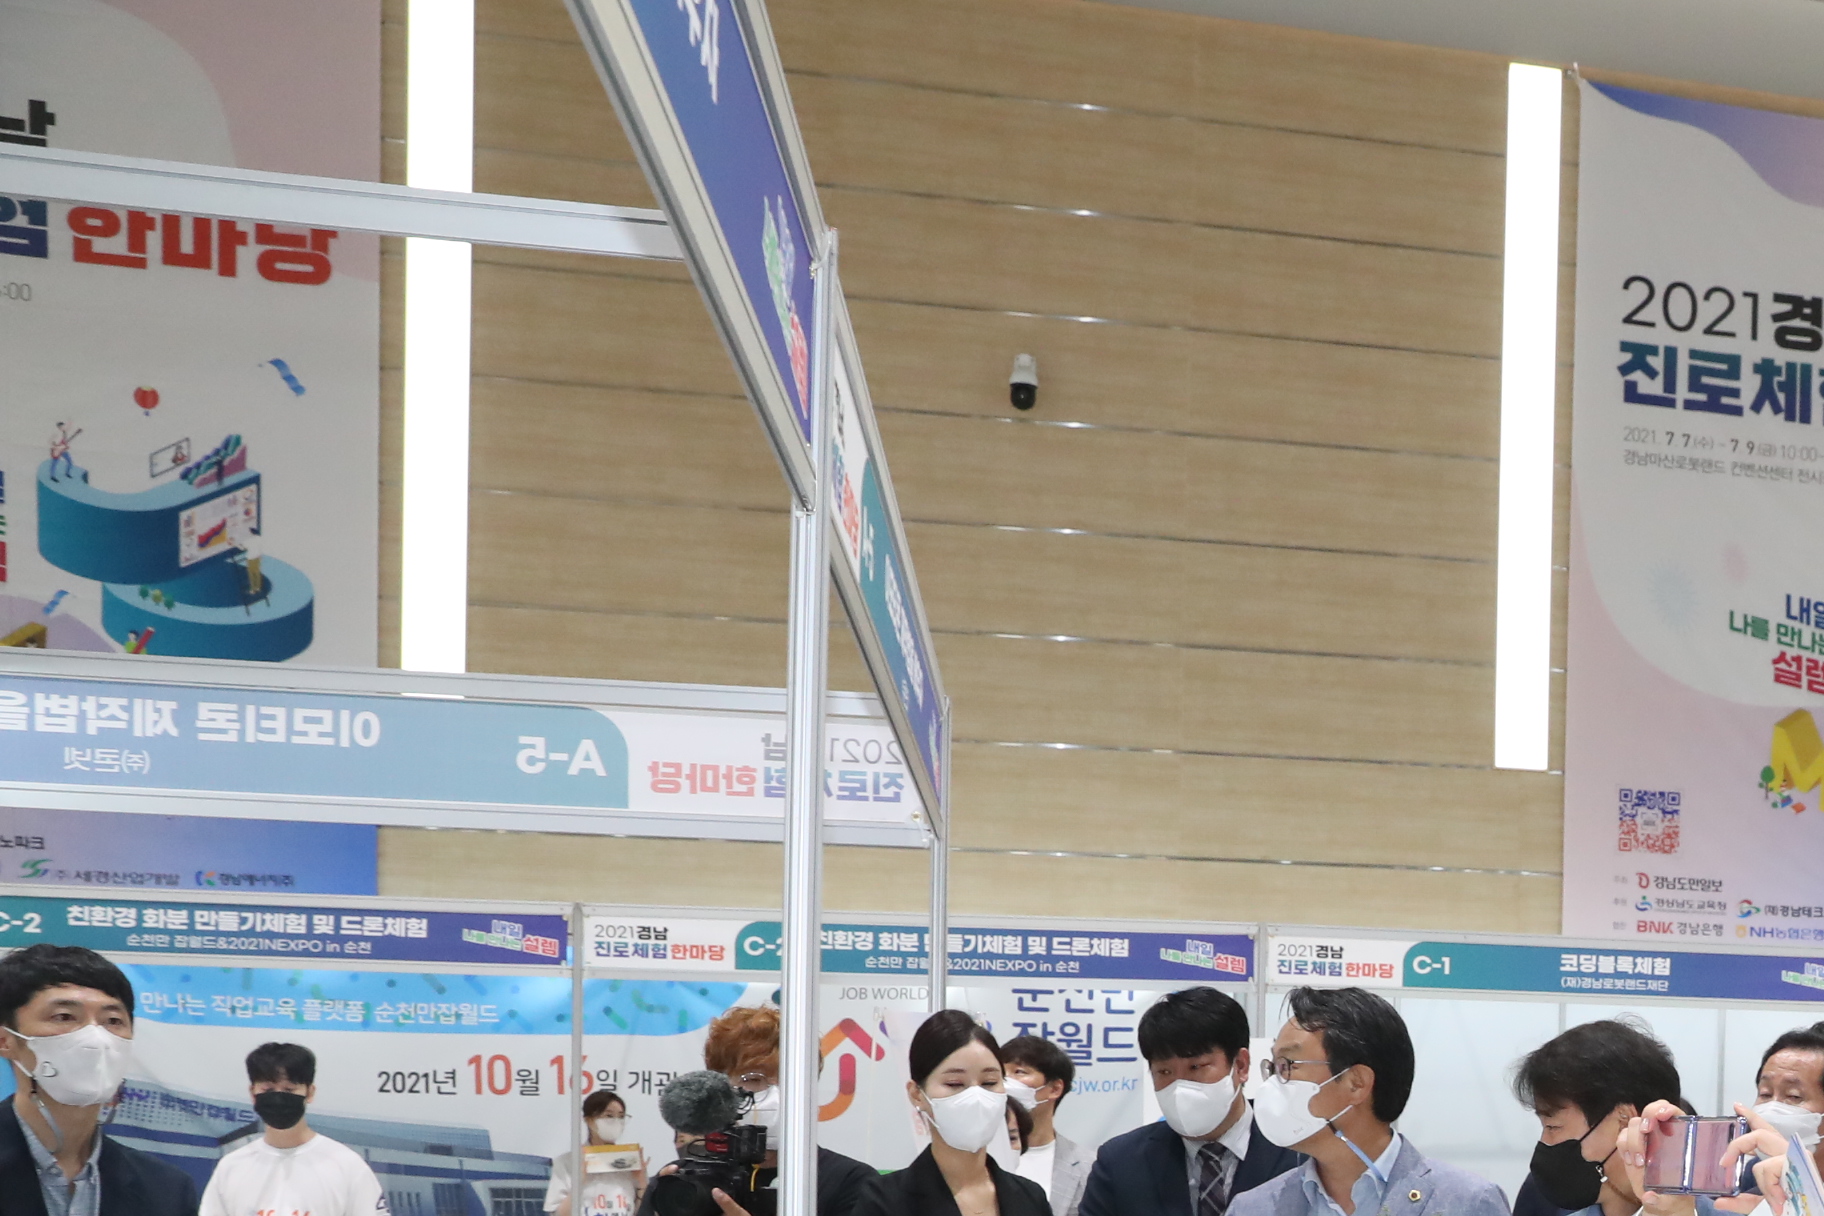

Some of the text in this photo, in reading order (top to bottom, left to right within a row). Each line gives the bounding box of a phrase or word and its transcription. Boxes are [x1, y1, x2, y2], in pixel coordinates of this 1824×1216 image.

[1729, 610, 1769, 642] 나를
[66, 904, 138, 928] 친환경
[142, 908, 190, 931] 화분
[194, 910, 308, 935] 만들기체험
[312, 913, 337, 936] 및
[340, 914, 429, 939] 드론체험
[1636, 920, 1674, 935] BNK
[126, 933, 171, 949] 순천만
[325, 939, 341, 954] in
[344, 940, 372, 955] 순천
[594, 941, 726, 961] 진로체험 한마당
[878, 932, 919, 952] 화분
[923, 933, 1022, 956] 들기체험
[1027, 935, 1047, 956] 및
[1051, 937, 1130, 959] 드론체험
[865, 955, 903, 969] 순천만
[1039, 960, 1052, 973] in
[1055, 960, 1081, 974] 순천
[1276, 959, 1395, 979] 진로체험 한마당
[1412, 953, 1671, 976] C-1 코딩블록체험
[839, 987, 929, 1000] JOB WORLD
[139, 991, 500, 1026] 만나는 직업교육 플랫폼 순천만잡월드
[377, 1069, 458, 1096] 2021년
[466, 1053, 540, 1096] 10월
[1070, 1076, 1139, 1094] cjw.or.kr
